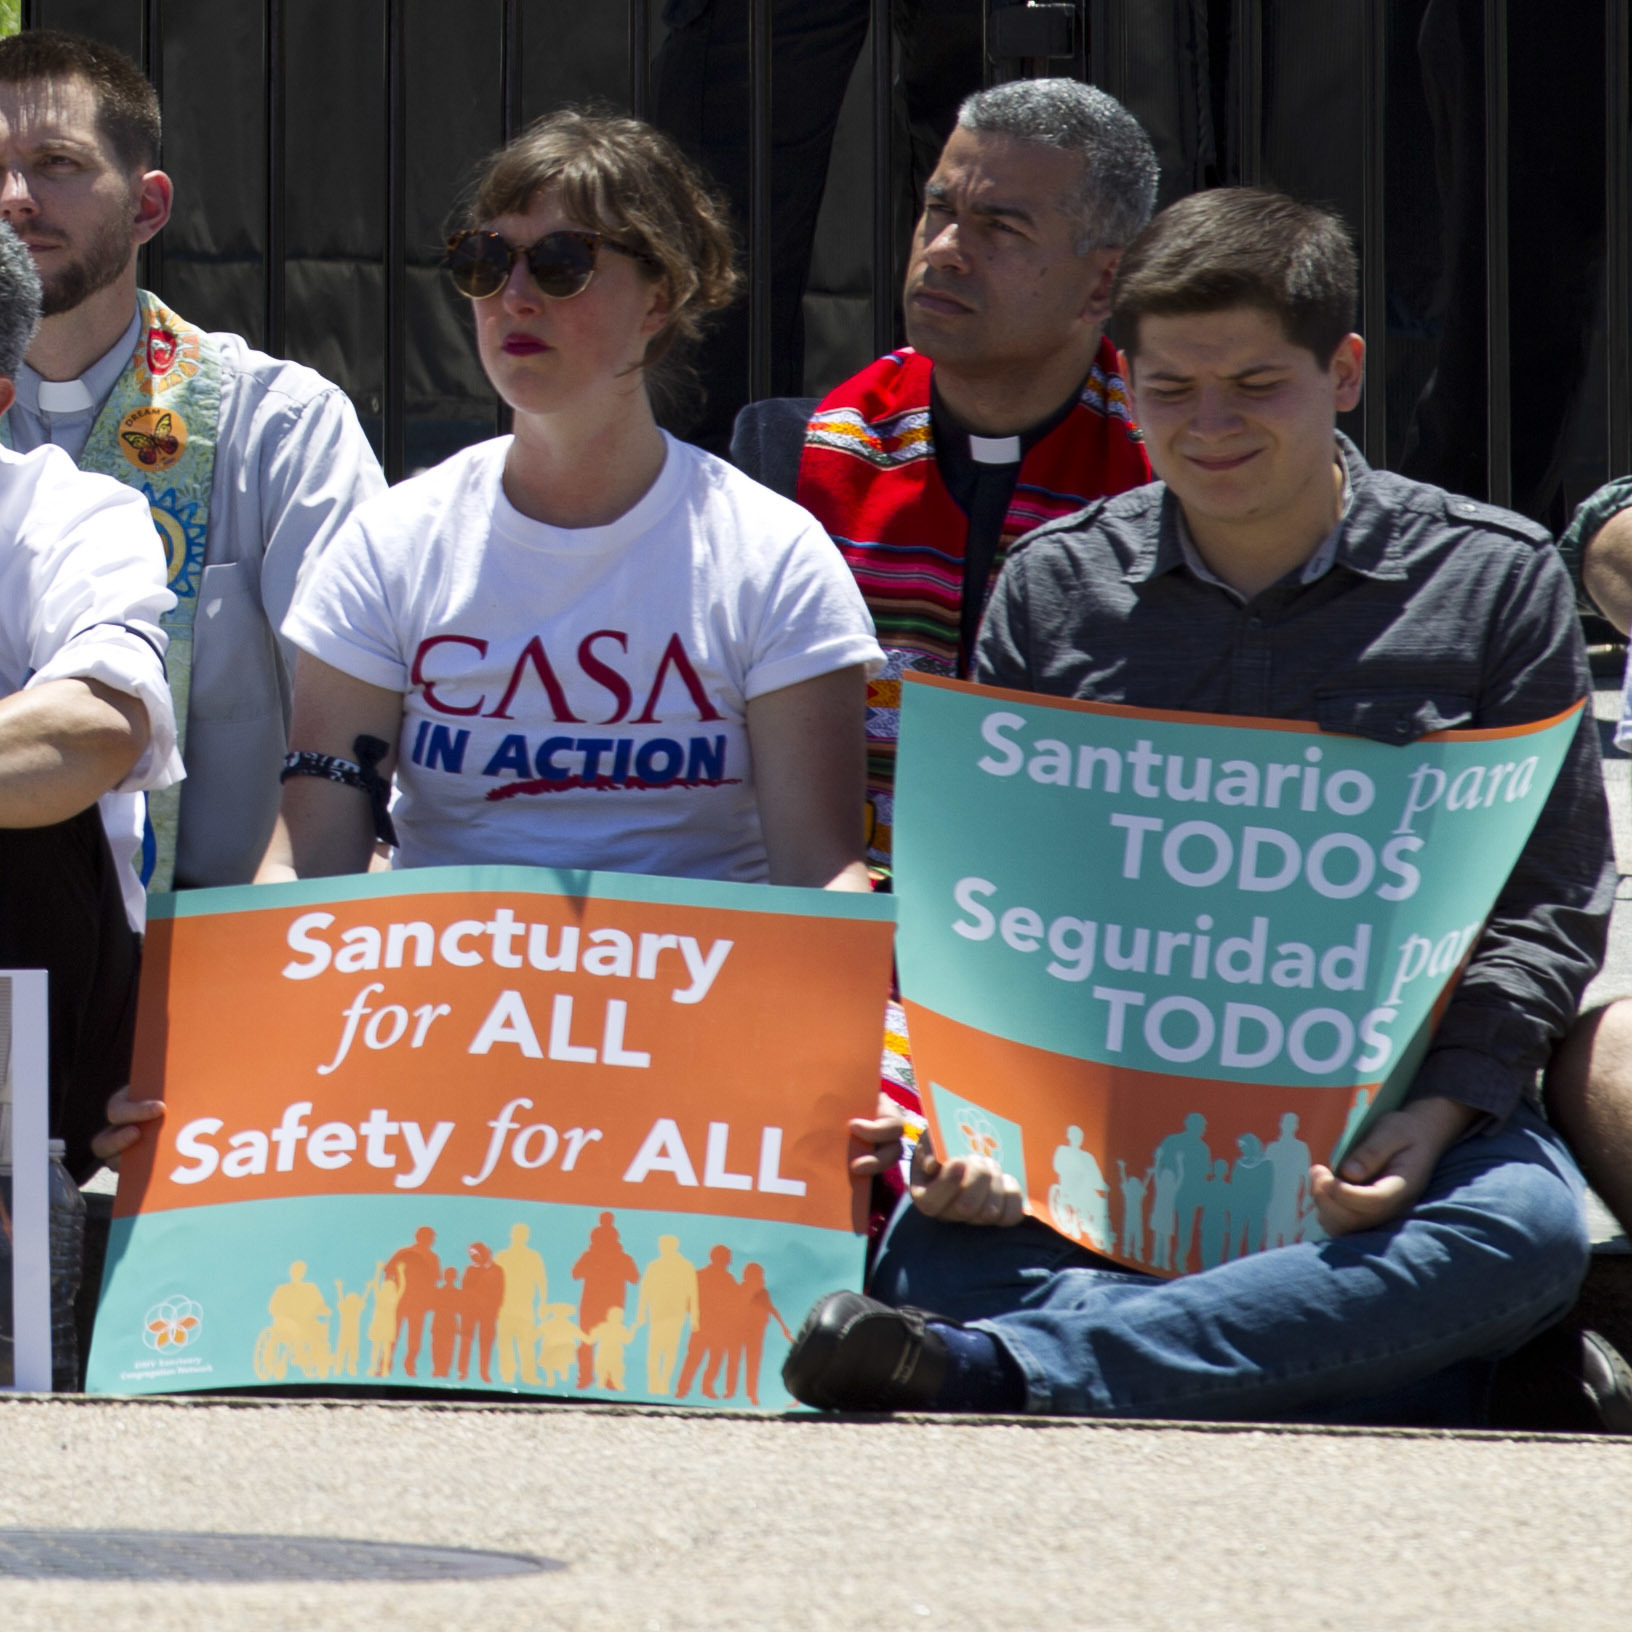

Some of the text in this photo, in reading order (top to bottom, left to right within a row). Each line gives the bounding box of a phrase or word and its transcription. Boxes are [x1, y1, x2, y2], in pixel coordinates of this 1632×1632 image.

[125, 409, 161, 427] DREAM
[411, 629, 729, 725] CASA
[412, 720, 471, 774] IN
[482, 733, 728, 785] ACTION
[977, 712, 1539, 834] Santuario para
[1110, 813, 1425, 901] TODOS
[283, 908, 734, 1005] Sanctuary
[952, 877, 1372, 992] Seguridad
[317, 982, 651, 1076] for ALL
[1093, 986, 1394, 1075] TODOS
[168, 1097, 807, 1197] Safety for ALL
